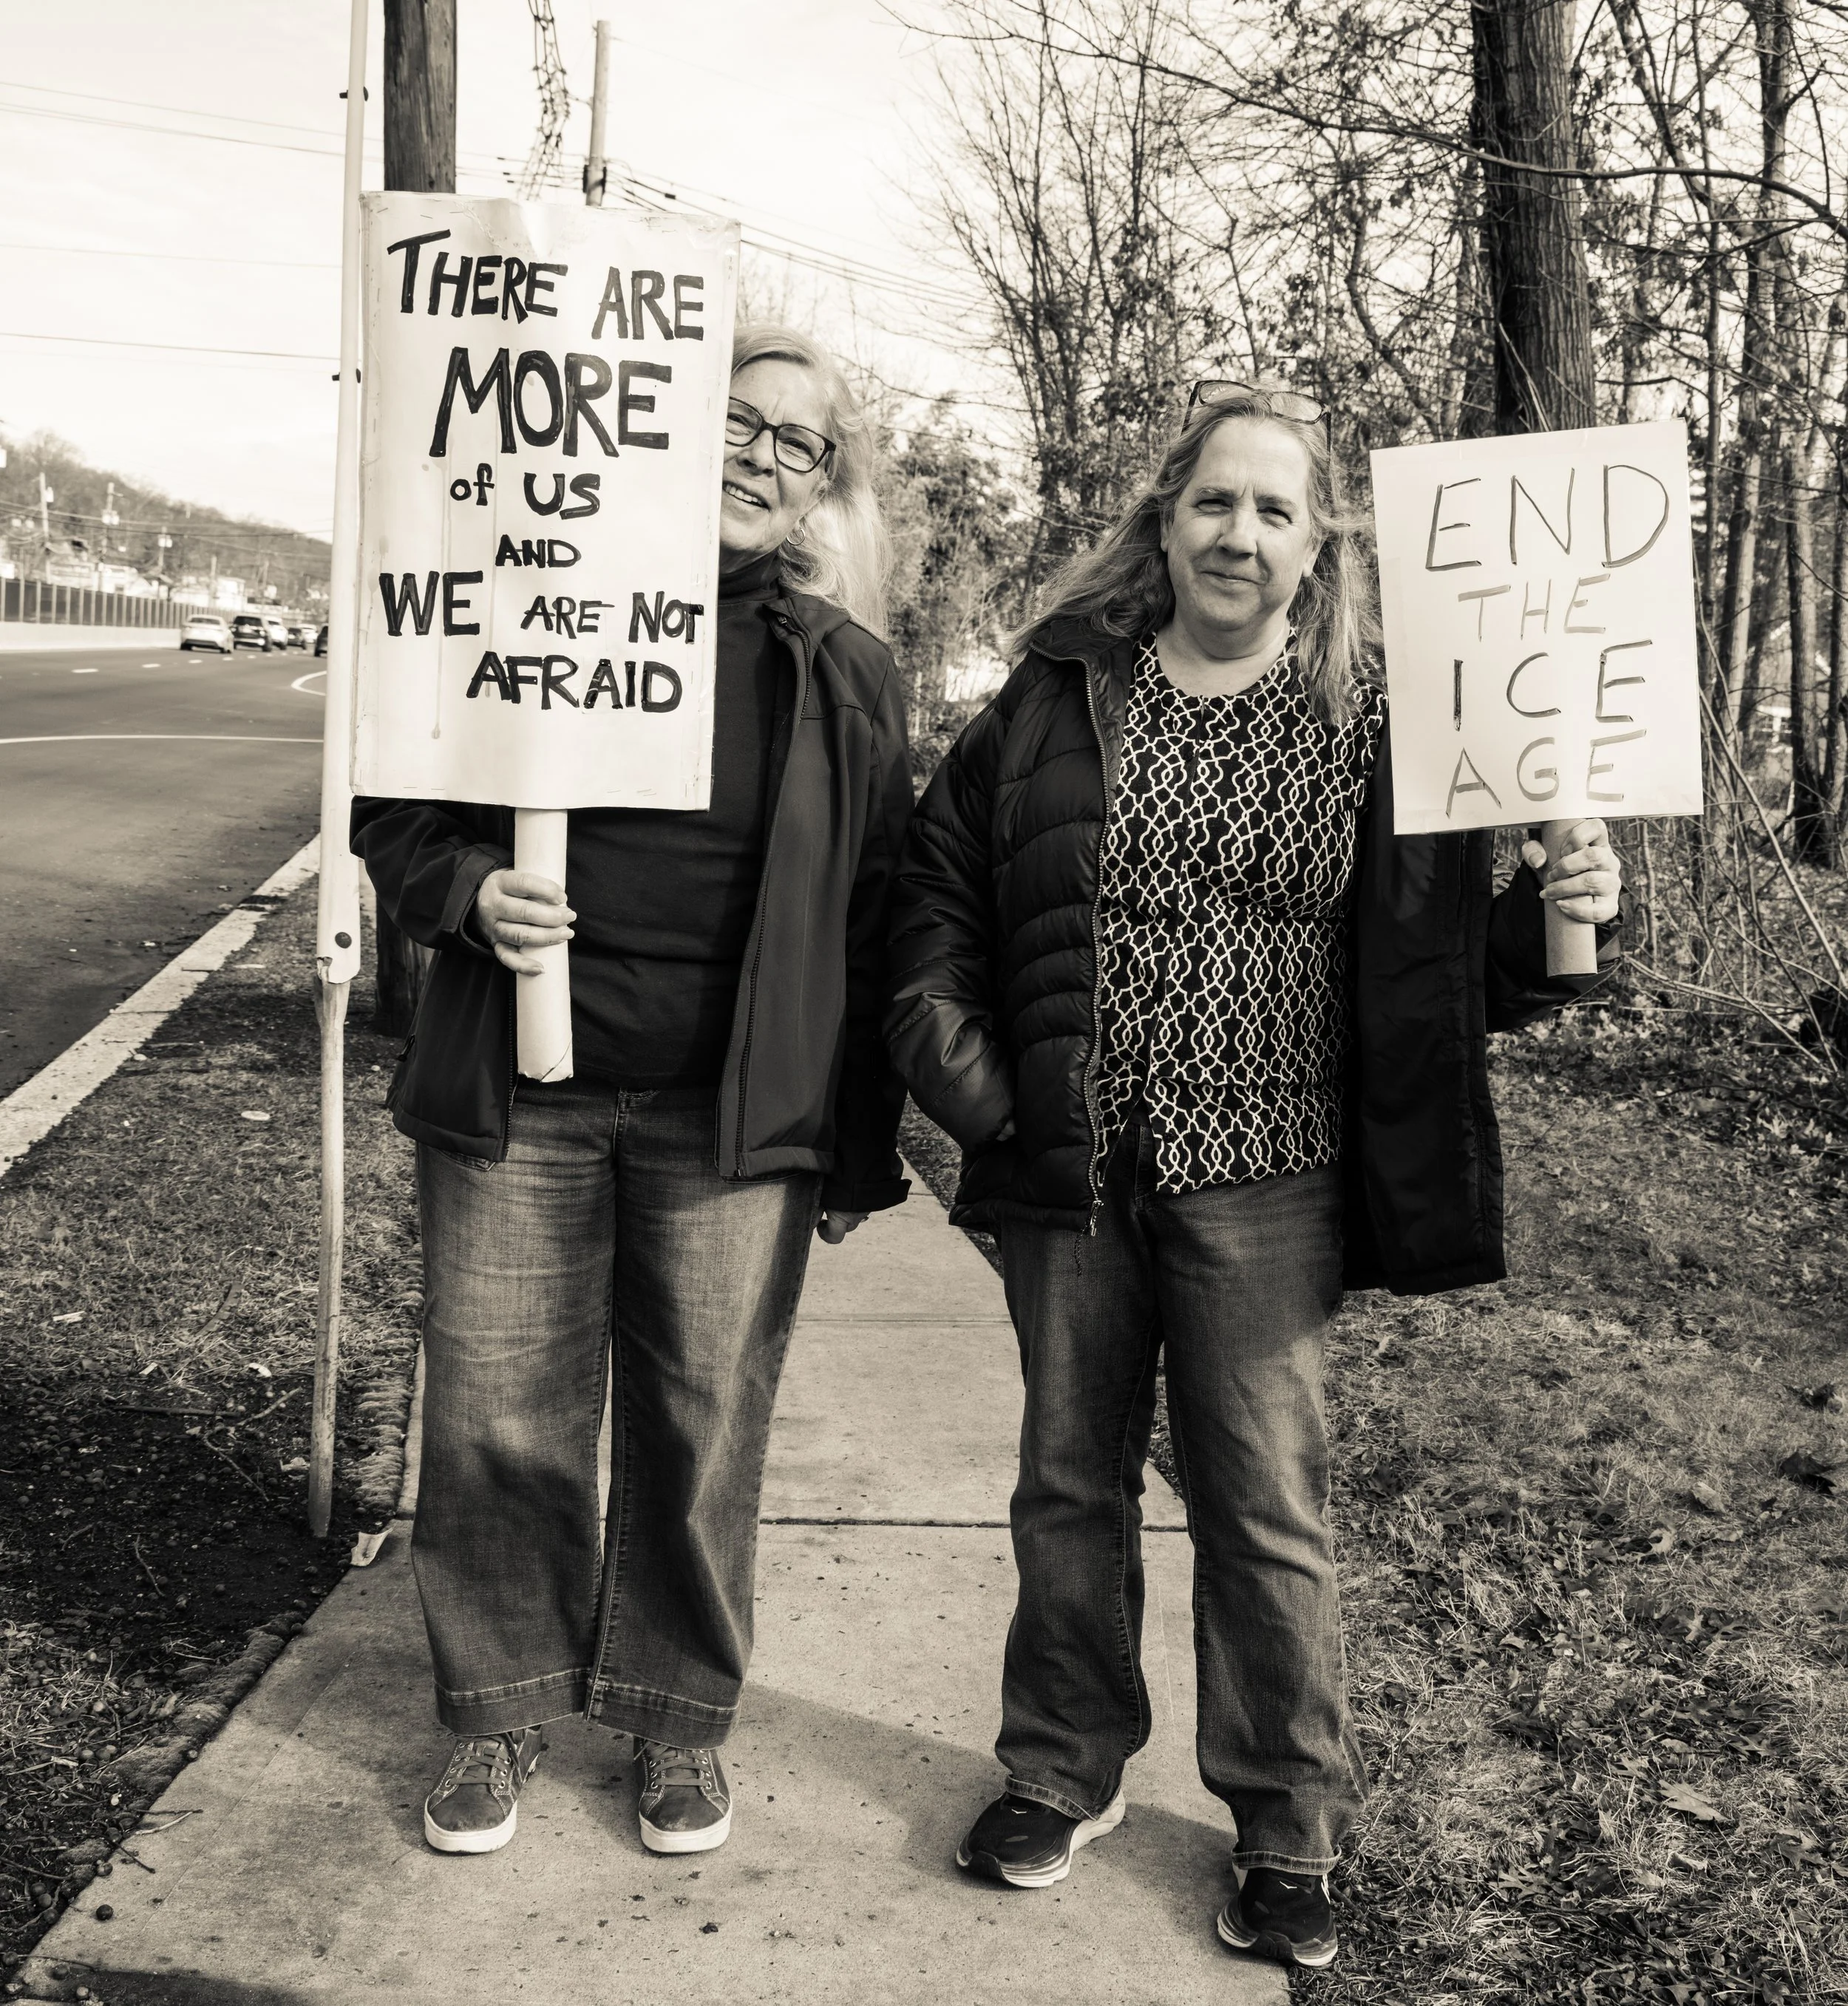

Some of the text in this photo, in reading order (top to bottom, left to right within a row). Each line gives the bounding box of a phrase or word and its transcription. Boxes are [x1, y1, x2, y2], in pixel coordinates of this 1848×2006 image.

[387, 229, 704, 341] THERE ARE
[429, 347, 672, 458] MORE
[449, 463, 600, 520] of US
[1425, 464, 1670, 571] END
[495, 534, 582, 568] AND
[378, 571, 704, 644] WE ARE NOT
[1458, 573, 1611, 642] THE
[466, 651, 682, 713] AFRAID
[1453, 639, 1653, 731] ICE
[1446, 729, 1647, 819] AGE
